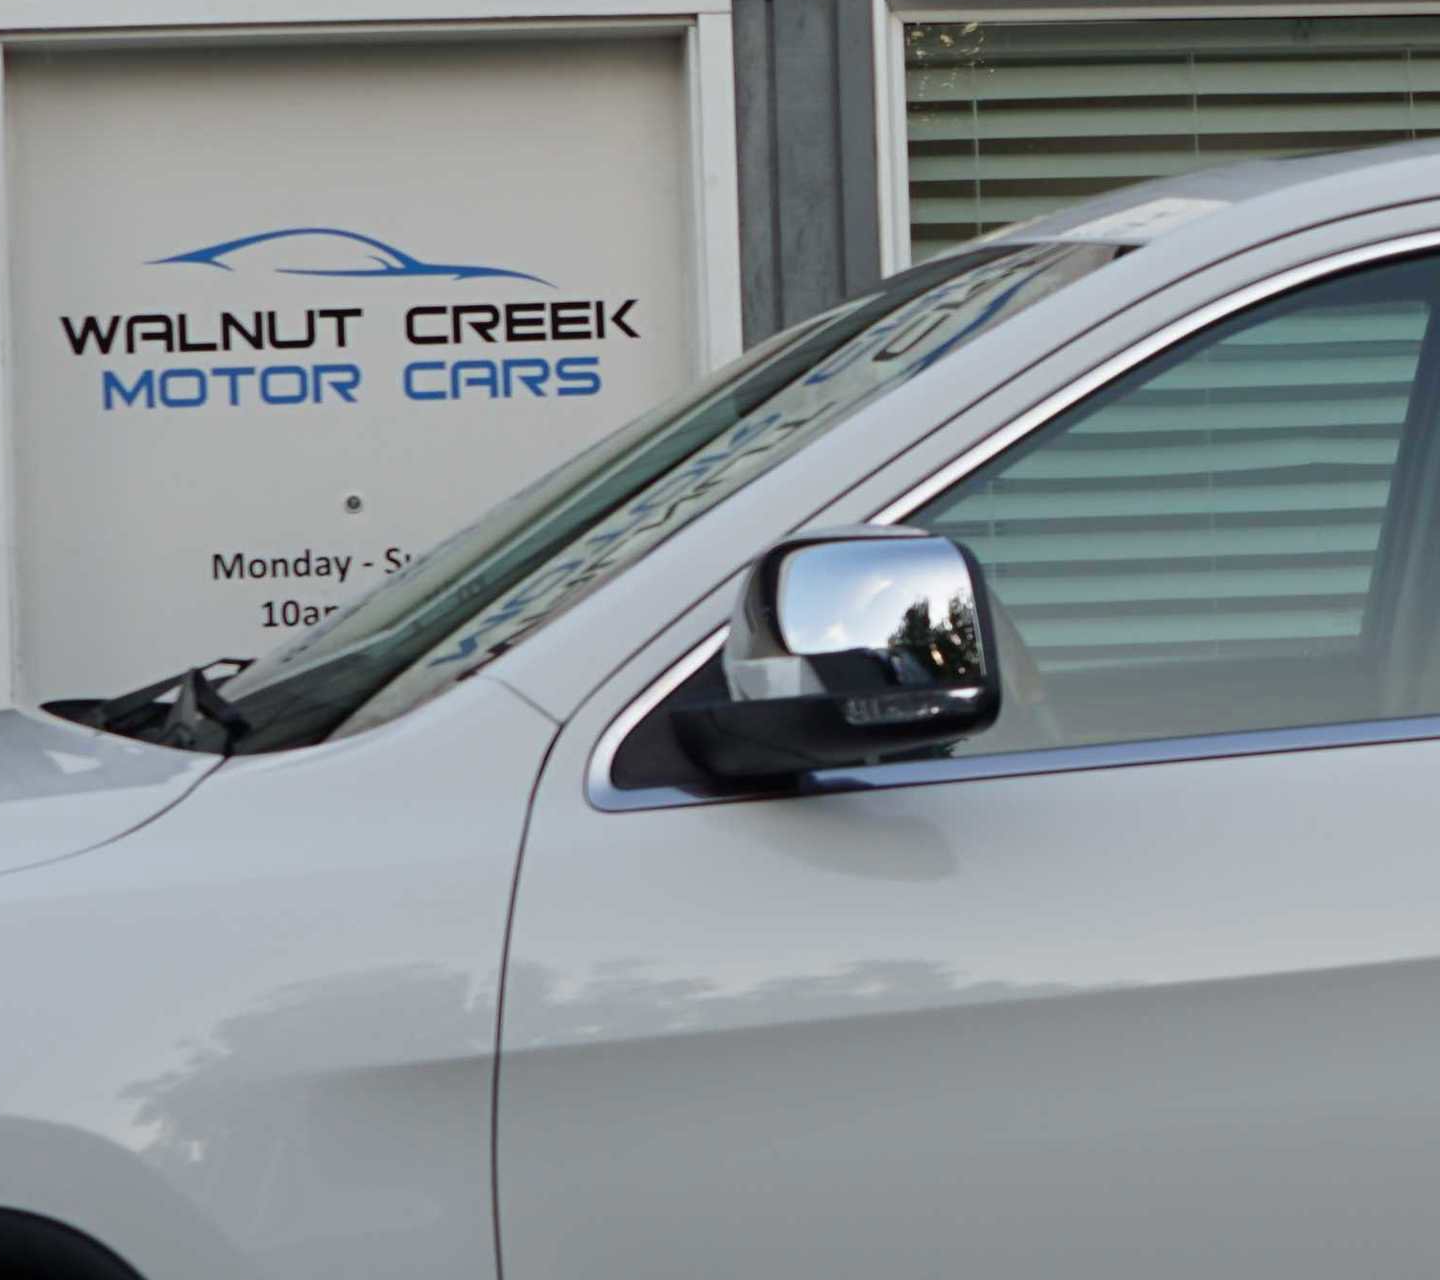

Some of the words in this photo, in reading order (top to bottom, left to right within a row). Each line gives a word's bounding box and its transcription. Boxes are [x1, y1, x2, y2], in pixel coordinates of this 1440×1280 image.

[60, 307, 363, 356] WALNUT
[405, 298, 640, 347] CREEK
[102, 363, 362, 411] MOTOR
[402, 355, 603, 402] CARS
[212, 549, 352, 583] Monday
